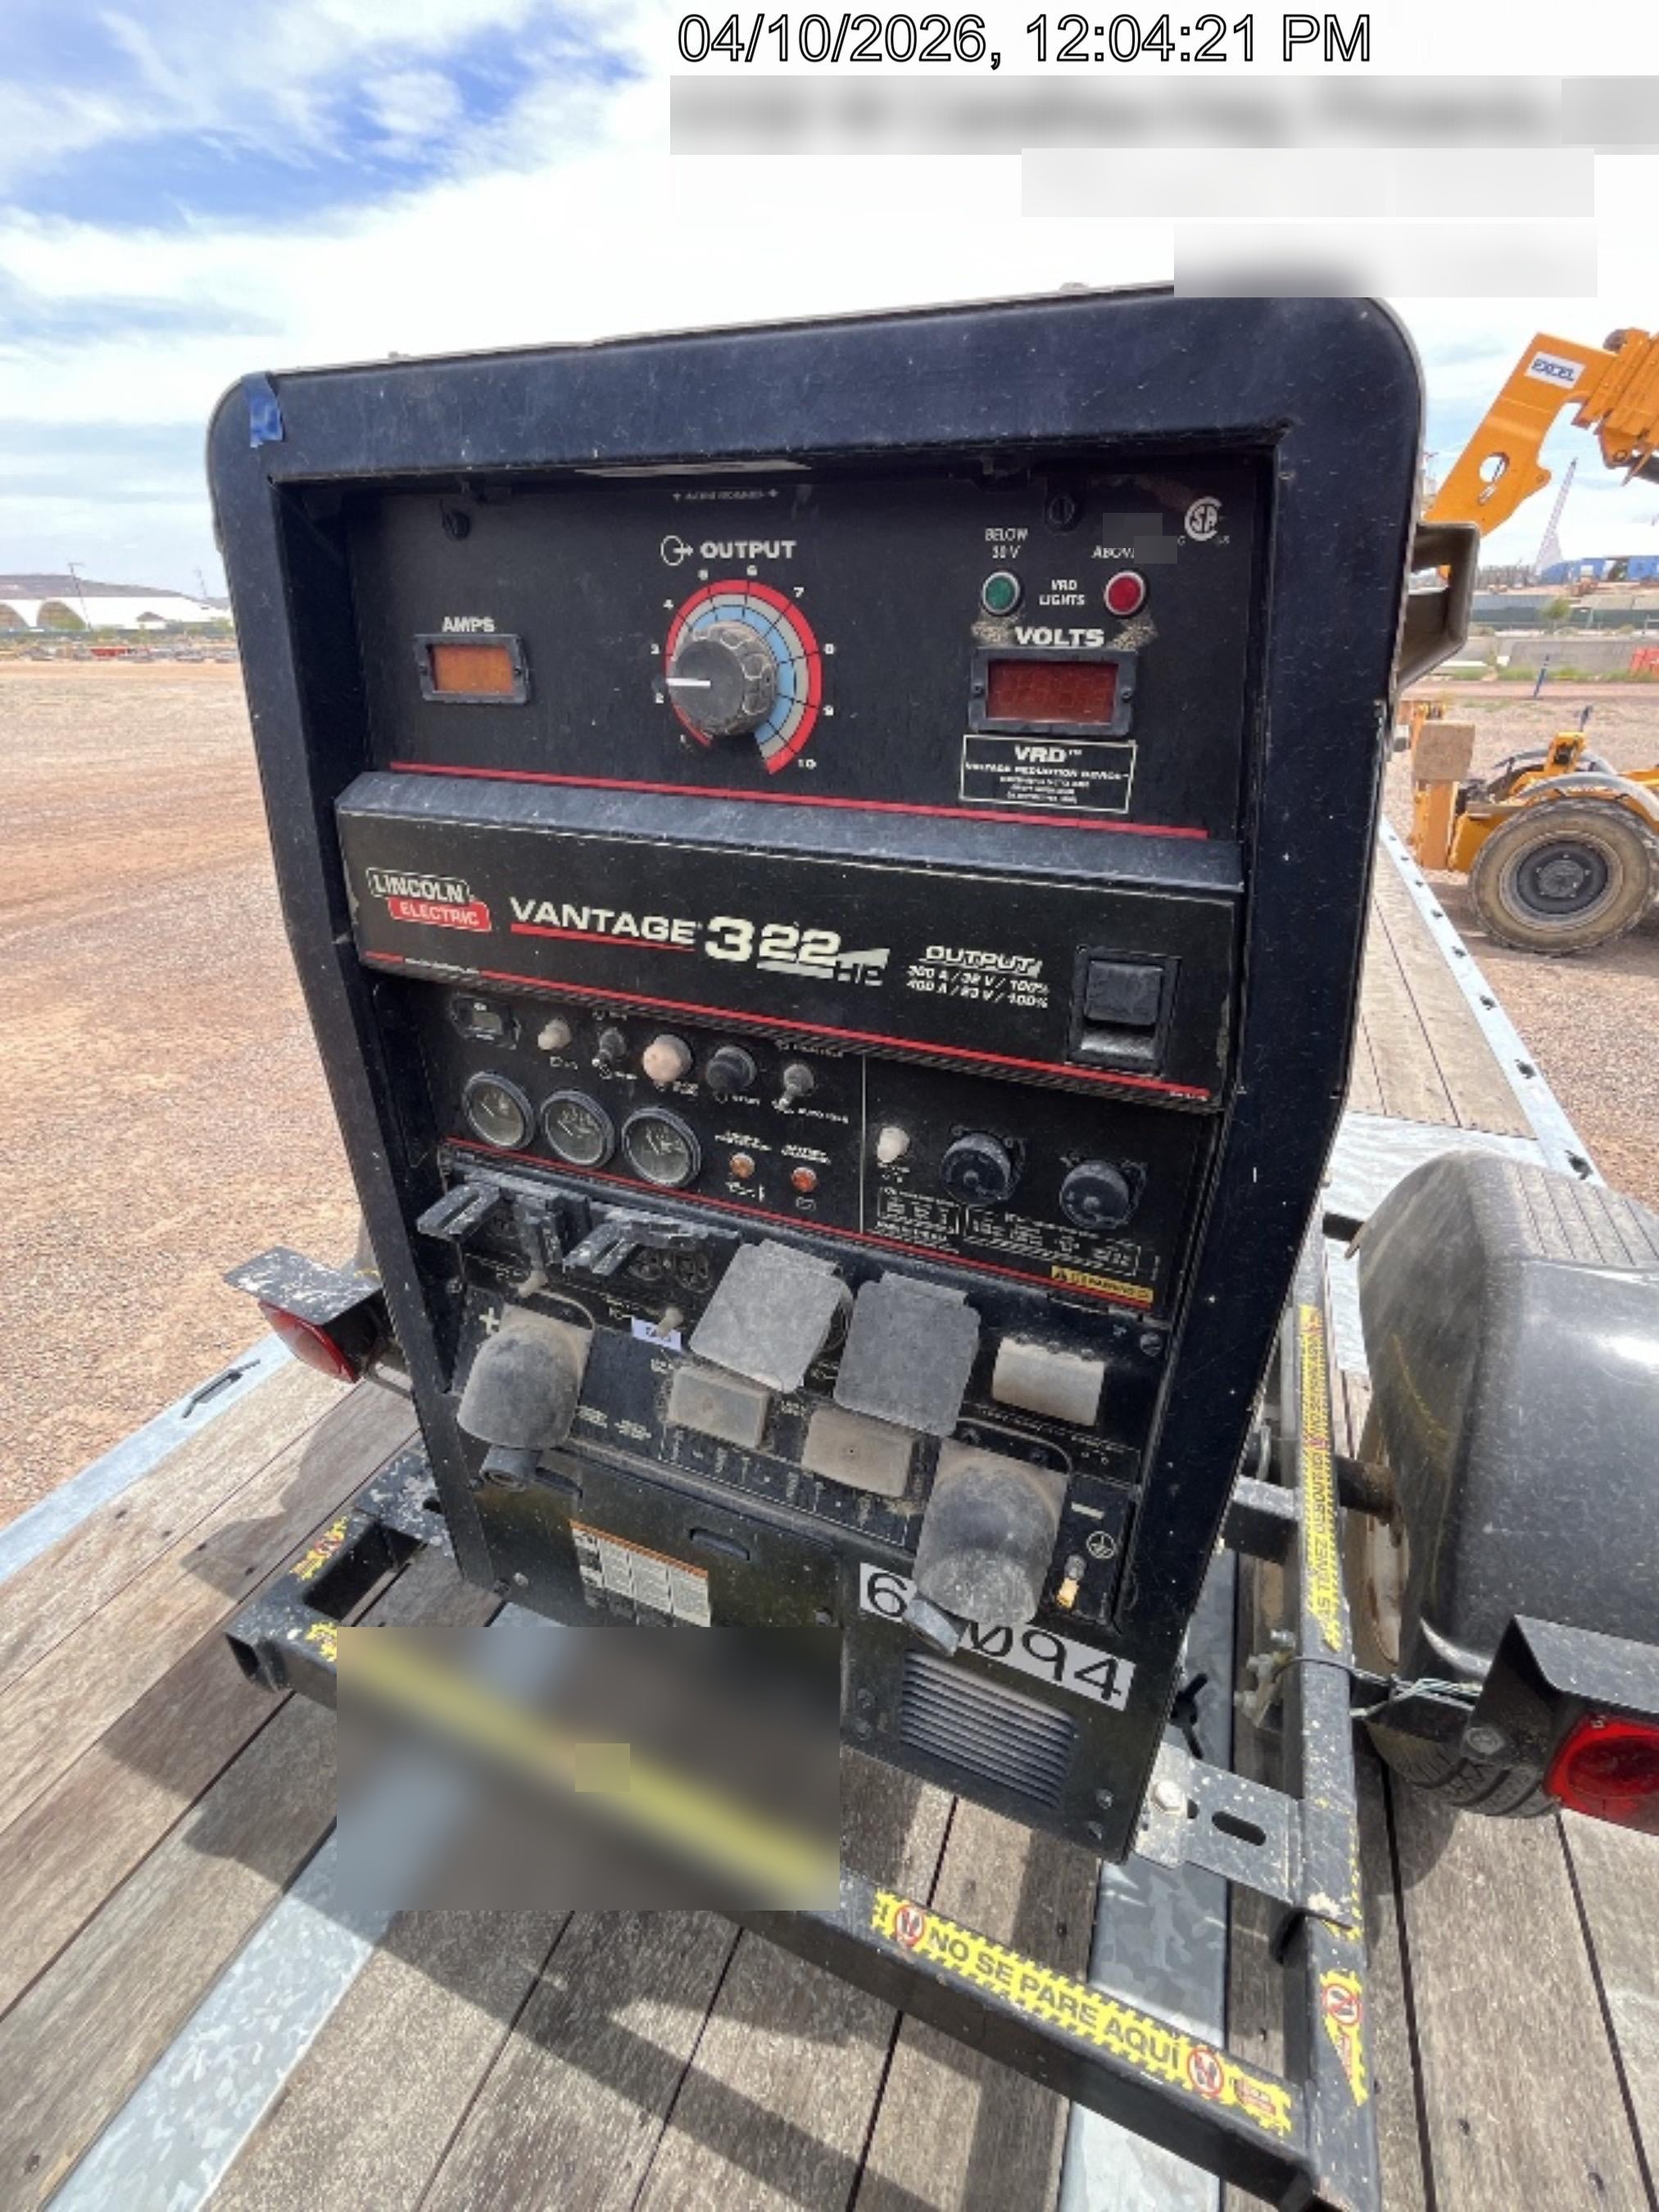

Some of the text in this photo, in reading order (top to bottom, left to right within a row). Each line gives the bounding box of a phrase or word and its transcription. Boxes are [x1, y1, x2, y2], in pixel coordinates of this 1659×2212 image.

[985, 528, 1028, 542] BELOW
[700, 540, 797, 559] OUTPUT
[1091, 545, 1135, 559] ABOV
[793, 587, 805, 598] 7
[1051, 579, 1077, 591] VRD
[663, 599, 674, 610] 4
[1039, 595, 1085, 605] LIGHTS
[442, 616, 495, 632] AMPS
[1014, 626, 1104, 647] VOLTS
[798, 758, 817, 769] 10
[373, 874, 465, 903] LINCOLN
[400, 902, 479, 926] ELECTRIC
[510, 896, 696, 945] VANTAGE
[705, 916, 842, 968] 322
[926, 945, 1036, 972] OUTPUT
[867, 1572, 1122, 1702] 6094
[929, 1927, 968, 1962] NO
[976, 1951, 1014, 1987] SE
[1020, 1973, 1099, 2030] PARE
